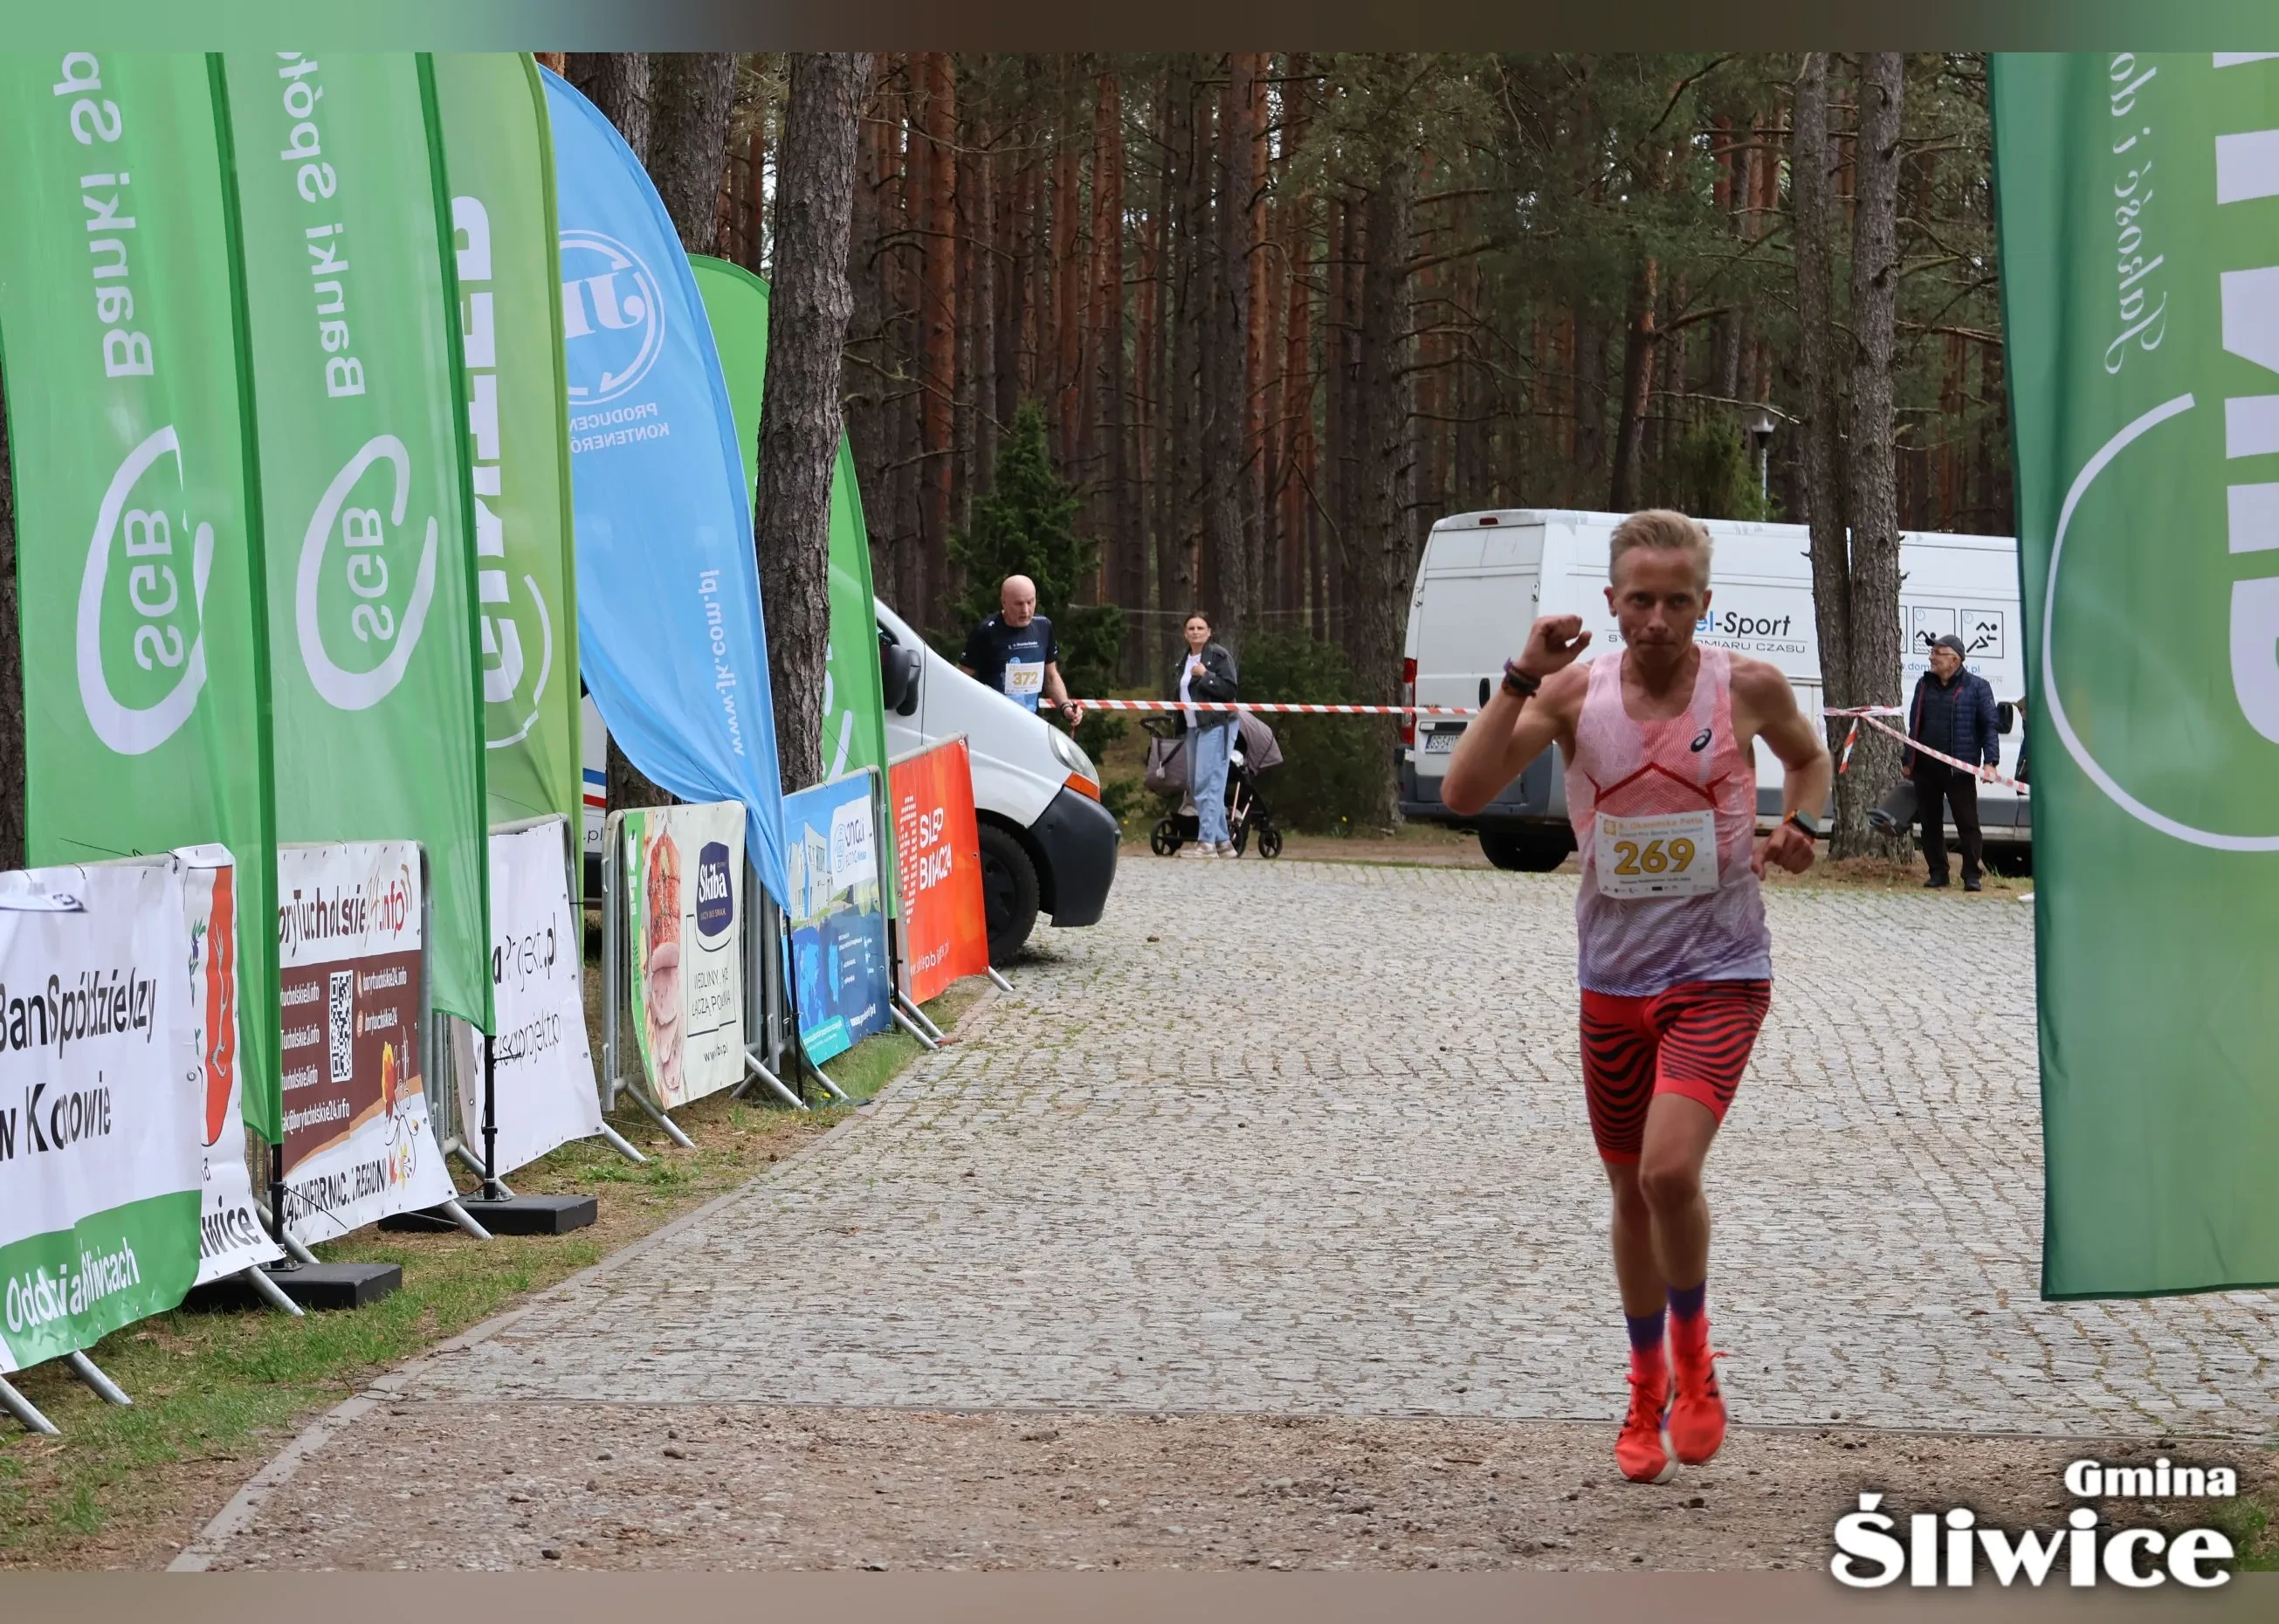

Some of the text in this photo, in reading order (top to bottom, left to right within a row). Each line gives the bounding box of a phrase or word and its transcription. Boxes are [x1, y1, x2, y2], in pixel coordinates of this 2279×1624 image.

[1756, 643, 1806, 654] CZASU
[1013, 671, 1038, 685] 372
[1614, 837, 1695, 875] 269
[699, 863, 728, 903] Skiba
